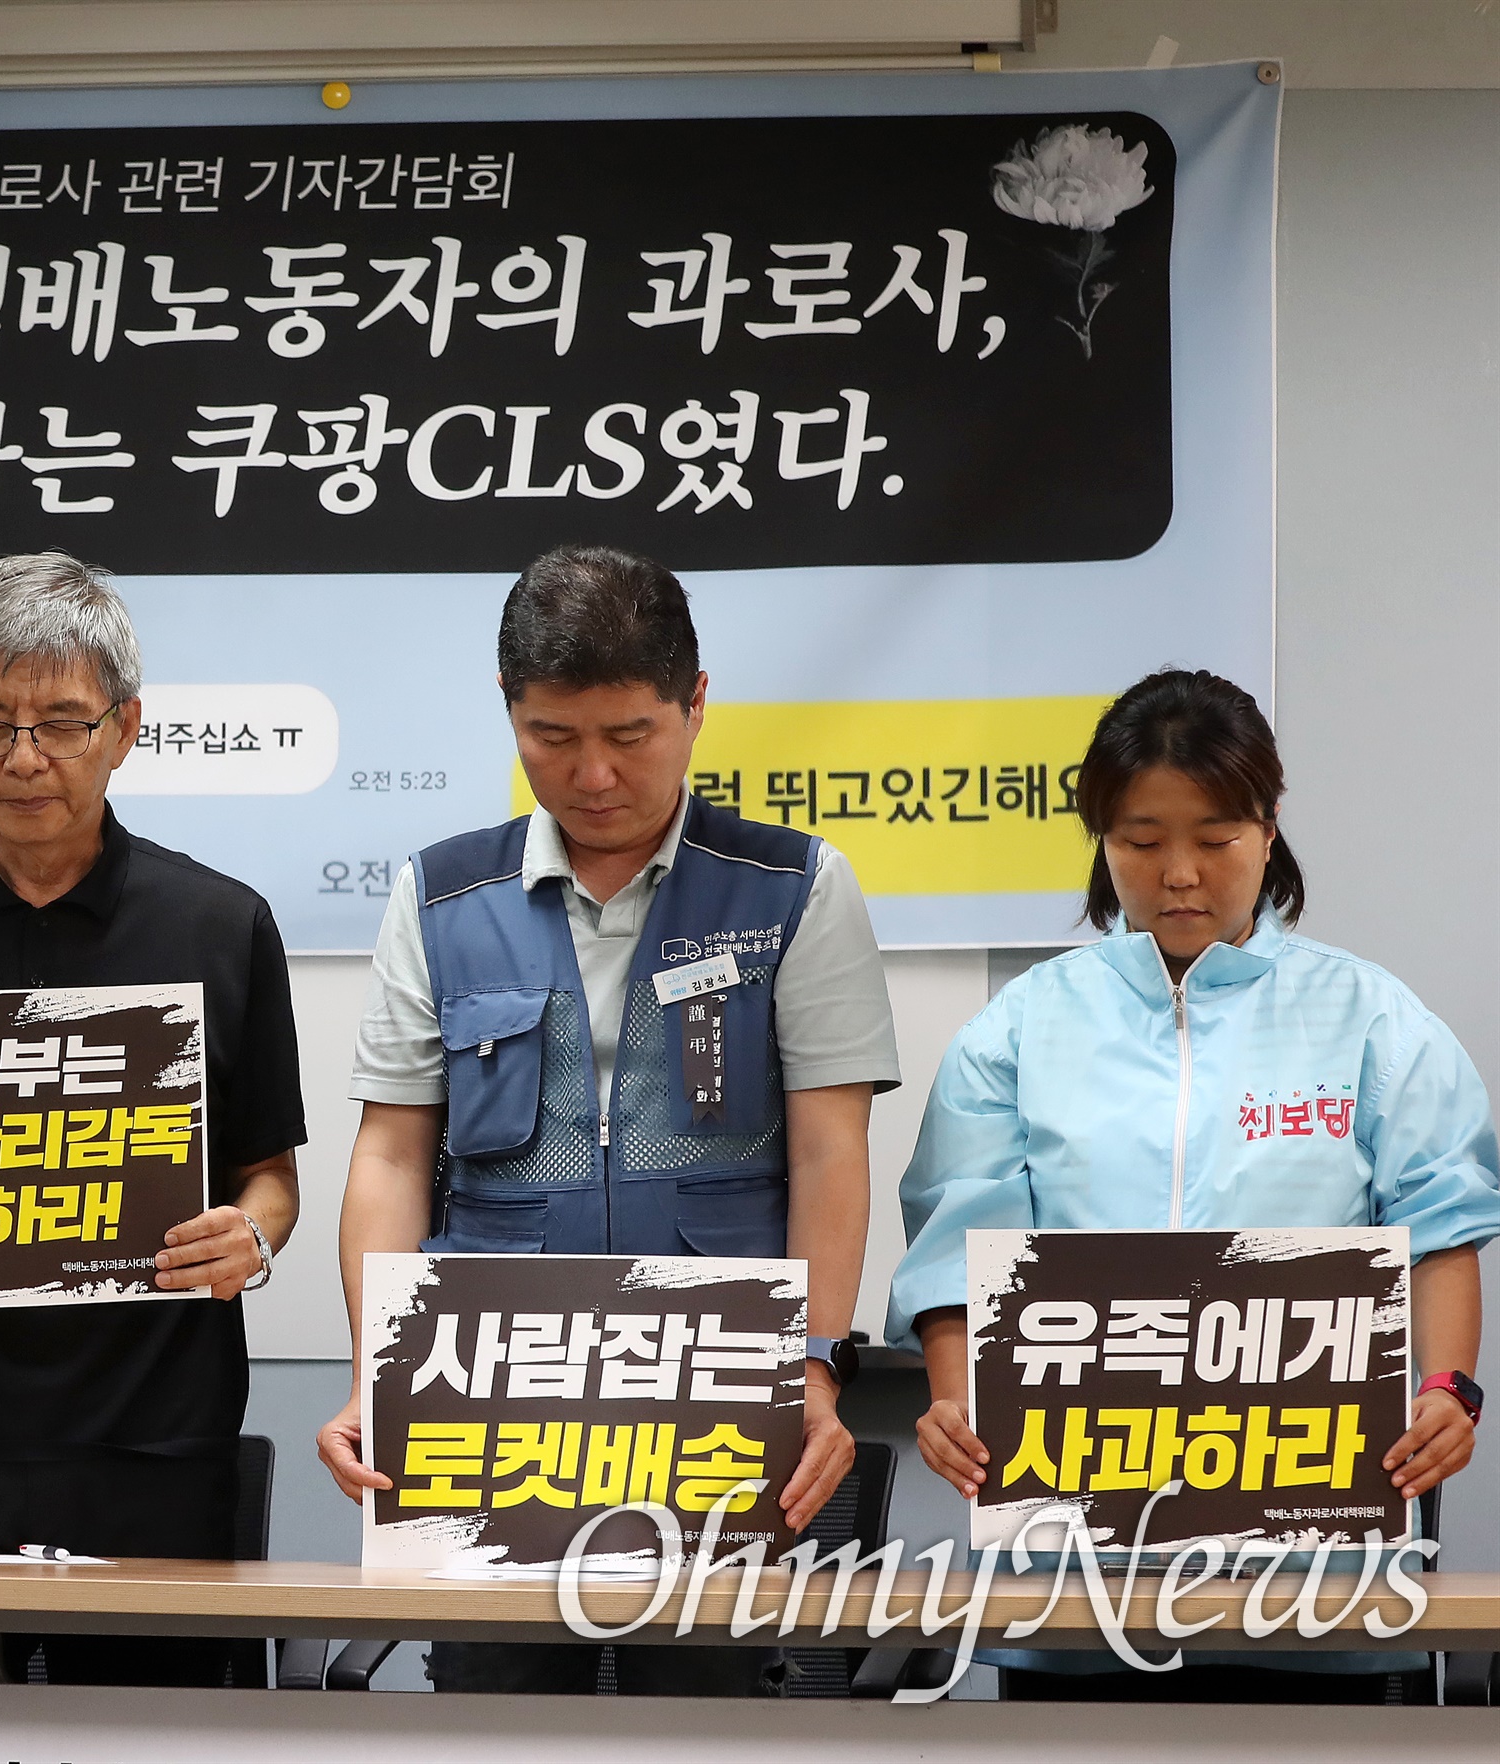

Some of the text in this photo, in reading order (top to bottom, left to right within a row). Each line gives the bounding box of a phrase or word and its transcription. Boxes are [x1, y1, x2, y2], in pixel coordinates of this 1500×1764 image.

[118, 156, 224, 214] 관련
[244, 152, 515, 212] 기자간담회
[627, 228, 1006, 360] 과로사,
[171, 388, 904, 518] 쿠팡CLS였다.
[350, 771, 447, 792] 오전 5:23
[318, 860, 391, 898] 오전
[704, 930, 738, 945] 민주노총
[1238, 1098, 1355, 1141] 진보당
[410, 1311, 780, 1403] 사람잡는
[1012, 1296, 1375, 1386] 유족에게
[398, 1422, 766, 1513] 로켓배송
[1002, 1403, 1367, 1493] 사과하라
[1263, 1505, 1385, 1521] 택배노동자과로사대책위원회
